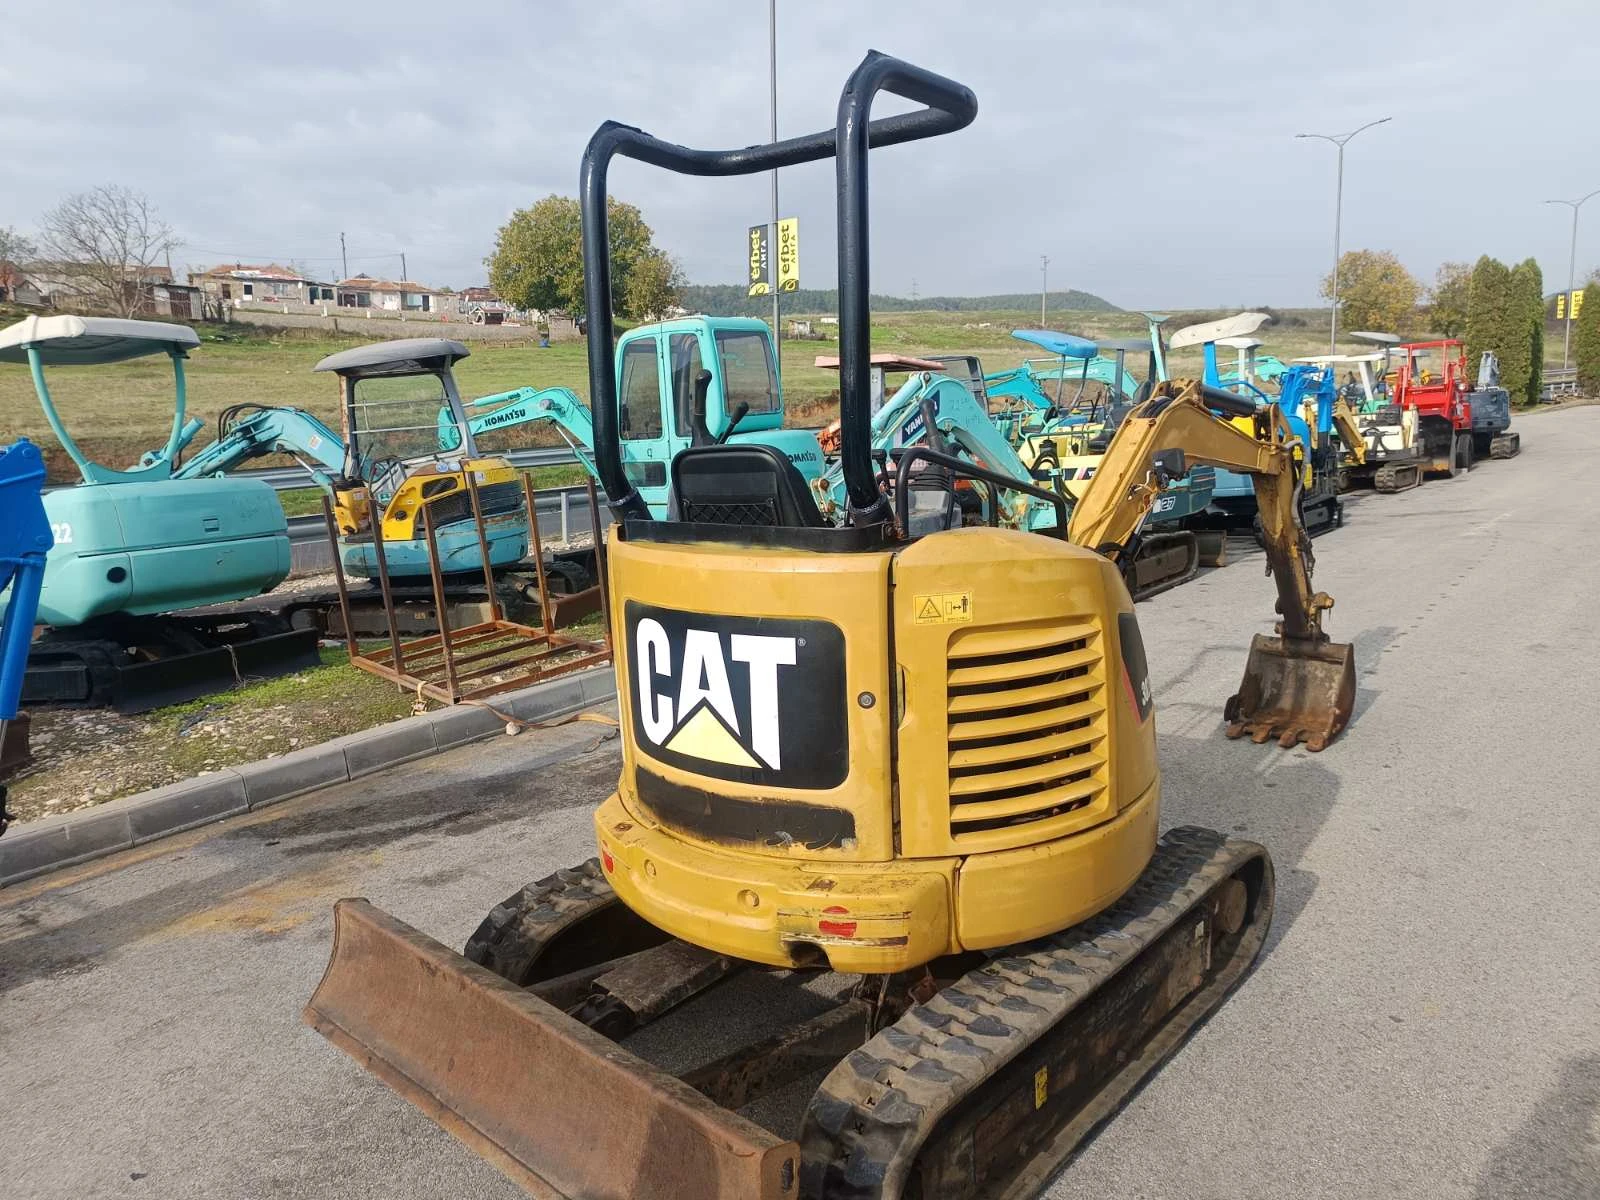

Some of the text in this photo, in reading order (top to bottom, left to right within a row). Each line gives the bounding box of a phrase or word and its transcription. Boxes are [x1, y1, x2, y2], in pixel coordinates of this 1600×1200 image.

[750, 228, 760, 280] efbet
[781, 224, 790, 274] efbet
[484, 408, 526, 427] KOMATSU
[636, 617, 797, 771] CAT
